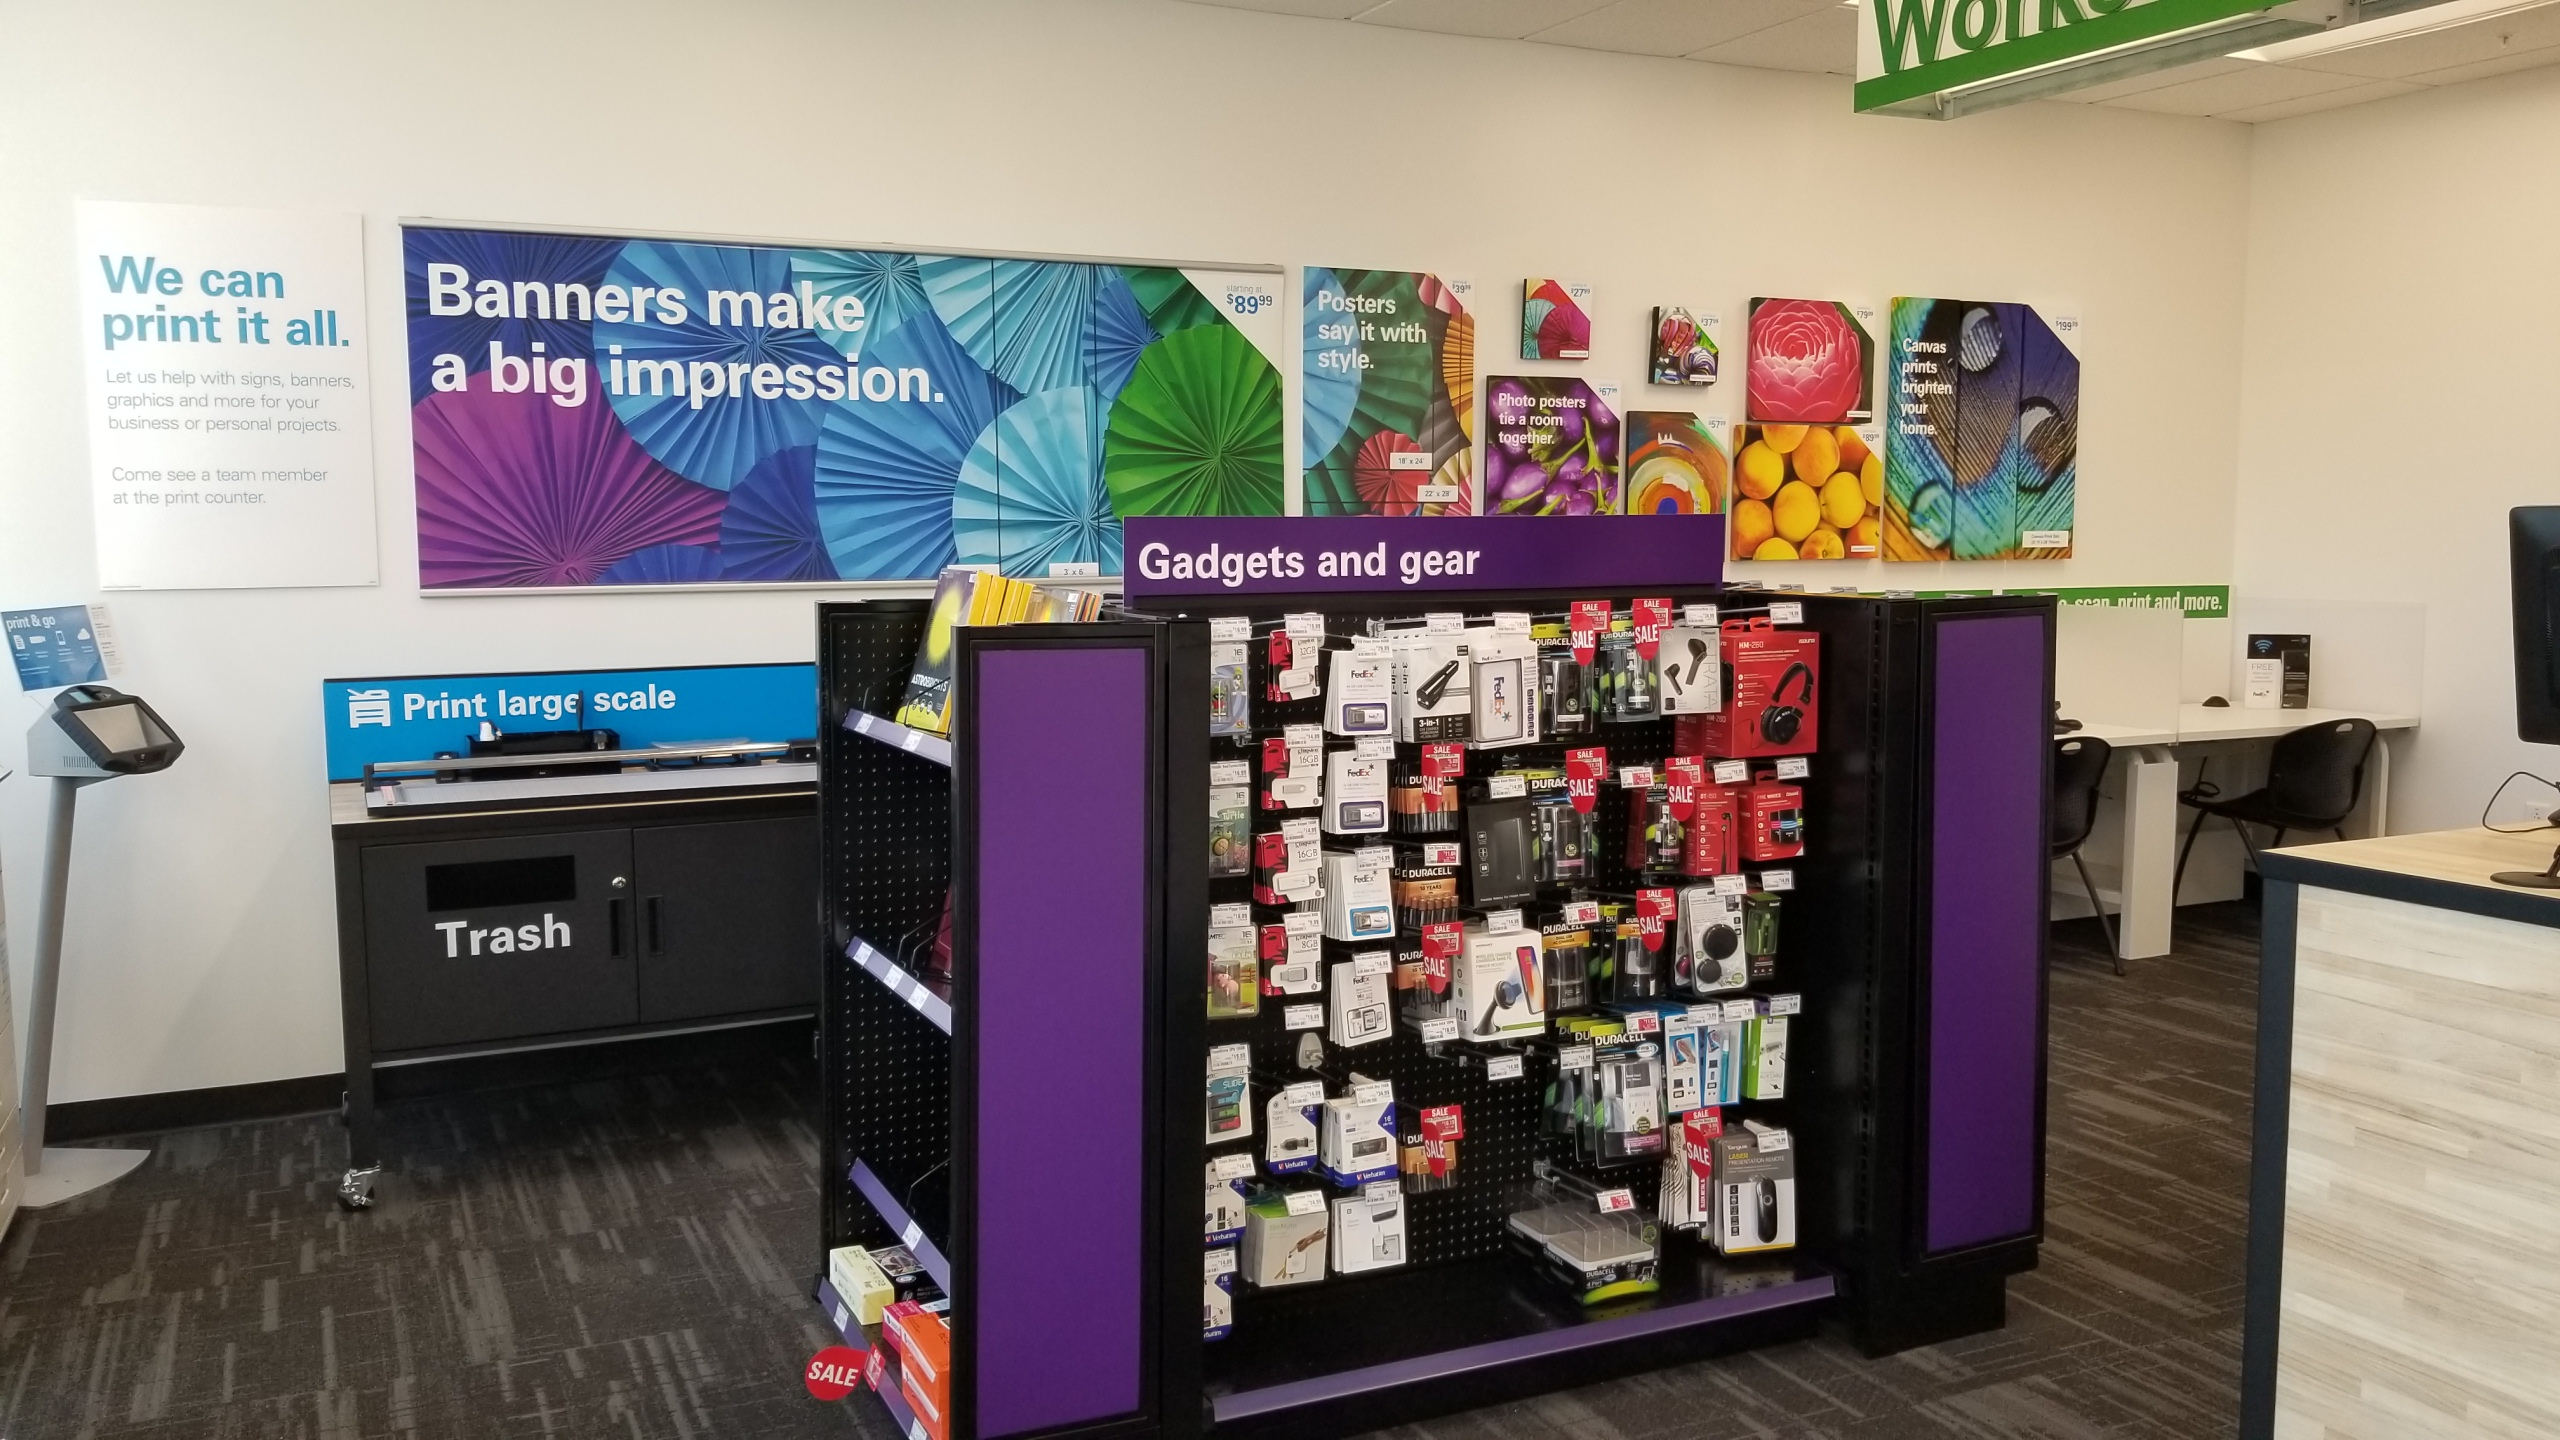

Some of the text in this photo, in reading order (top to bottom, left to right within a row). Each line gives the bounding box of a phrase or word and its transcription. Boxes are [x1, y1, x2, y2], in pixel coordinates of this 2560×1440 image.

[99, 255, 285, 299] We can
[427, 263, 866, 332] Banners make
[1226, 284, 1262, 295] starting at
[1318, 290, 1396, 314] Posters
[103, 304, 350, 350] print it all.
[1318, 320, 1427, 345] say it with
[1902, 338, 1946, 354] Canvas
[1318, 348, 1374, 374] style.
[1902, 359, 1938, 376] prints
[106, 369, 356, 390] Let us help with signs, banners,
[431, 341, 945, 410] a big impression.
[1901, 380, 1952, 398] brighten
[107, 394, 320, 412] graphics and more for your
[1498, 392, 1586, 412] Photo posters
[1900, 402, 1928, 417] your
[108, 415, 341, 434] business or personal projects.
[1498, 412, 1564, 426] tie a room
[1900, 420, 1938, 436] home.
[1498, 430, 1555, 446] together.
[112, 467, 328, 482] Come see a team member
[113, 490, 266, 507] at the print counter.
[1138, 543, 1481, 588] Gadgets and gear
[2154, 592, 2180, 610] and
[2184, 596, 2222, 611] more.
[6, 614, 56, 632] print & go
[1572, 630, 1594, 649] SALE
[1634, 624, 1659, 644] SALE
[1350, 670, 1374, 680] FedEx
[404, 684, 676, 722] Print large scale
[1494, 676, 1505, 716] FedEx
[1418, 719, 1440, 728] 3-in-1
[1434, 746, 1451, 754] SALE
[1577, 750, 1594, 759] SALE
[1300, 754, 1318, 764] 16GB
[1675, 758, 1691, 766] SALE
[1348, 768, 1370, 778] FedEx
[1422, 774, 1442, 796] SALE
[1532, 778, 1568, 789] DURAC
[1569, 778, 1595, 797] SALE
[1668, 786, 1693, 804] SALE
[1222, 812, 1245, 821] Turtle
[1298, 850, 1318, 858] 16GB
[1354, 874, 1374, 884] FedEx
[1408, 866, 1452, 878] DURACELL
[1646, 890, 1662, 898] SALE
[1434, 925, 1451, 934] SALE
[1543, 922, 1585, 935] DURACELL
[1640, 914, 1663, 935] SALE
[435, 912, 571, 958] Trash
[1301, 940, 1318, 949] 8GB
[1400, 951, 1424, 962] DURA
[1424, 956, 1447, 978] SALE
[1595, 1034, 1647, 1046] DURACELL
[1222, 1078, 1244, 1089] SLIDE
[1431, 1108, 1448, 1117] SALE
[1692, 1109, 1710, 1120] SALE
[1424, 1140, 1446, 1159] SALE
[1686, 1141, 1712, 1167] SALE
[1285, 1160, 1308, 1170] Verbatim
[1728, 1157, 1764, 1165] PRESENTATION
[1363, 1170, 1386, 1180] Verbatim
[1212, 1232, 1237, 1242] Verbatim
[1586, 1268, 1615, 1278] DURACELL
[1204, 1330, 1222, 1340] rbatim
[808, 1360, 859, 1388] SALE
